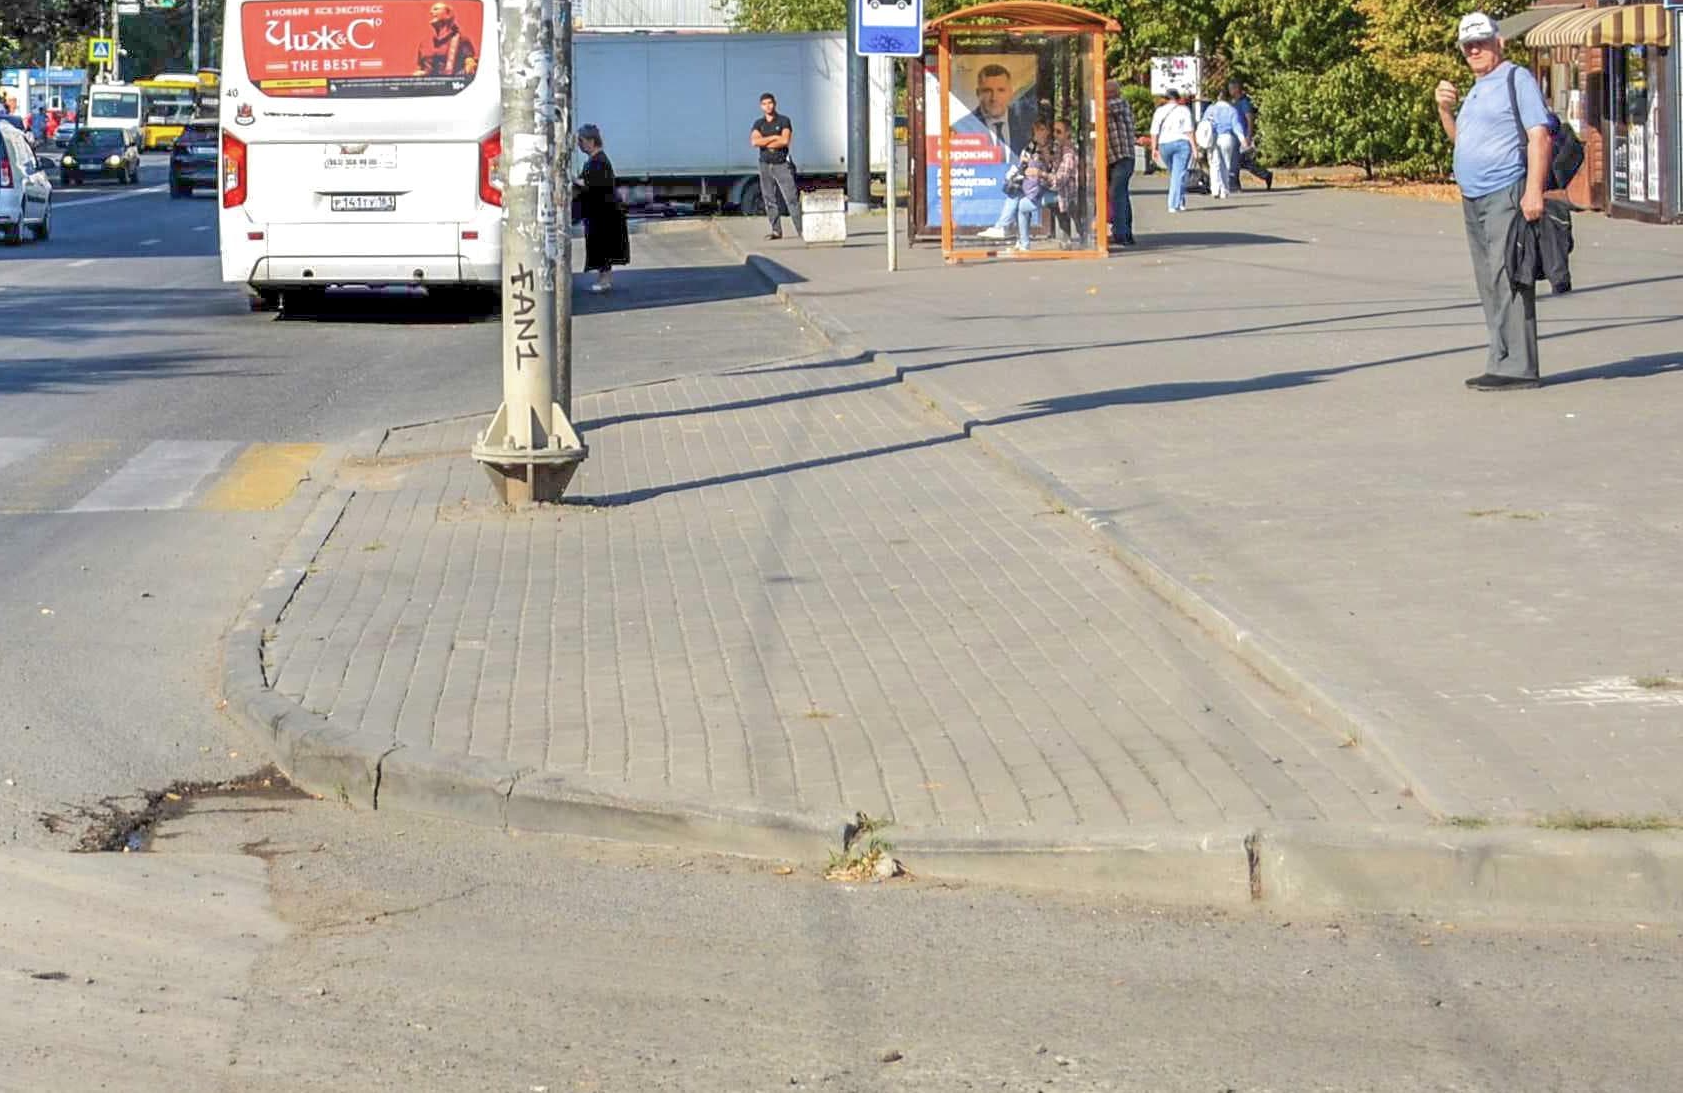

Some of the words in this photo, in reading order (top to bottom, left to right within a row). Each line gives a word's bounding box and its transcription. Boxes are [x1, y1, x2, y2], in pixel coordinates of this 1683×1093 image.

[291, 60, 318, 72] THE
[323, 58, 357, 71] BEST
[226, 88, 238, 98] 40
